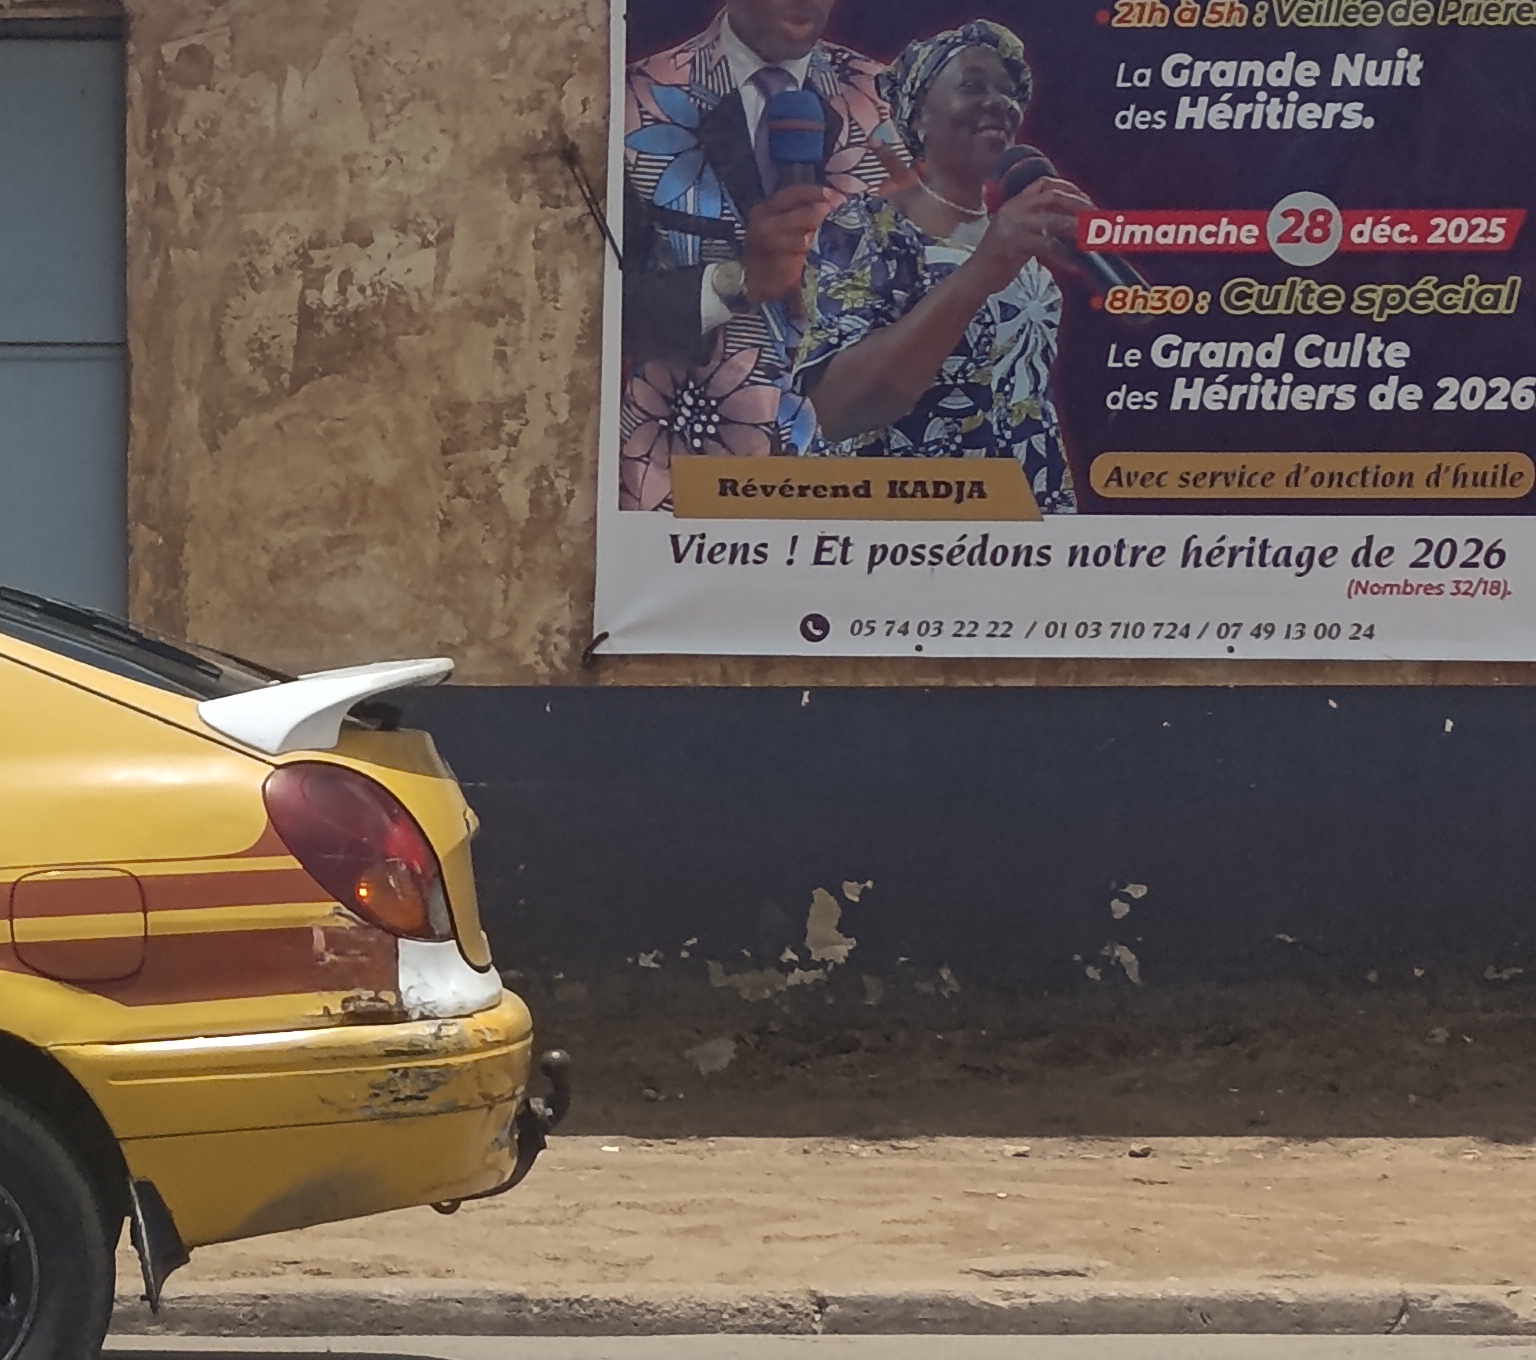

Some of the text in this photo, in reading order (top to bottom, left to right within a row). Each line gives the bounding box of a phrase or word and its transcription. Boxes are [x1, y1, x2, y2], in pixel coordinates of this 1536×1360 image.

[1116, 48, 1424, 88] La Grande Nuit
[1114, 91, 1375, 130] des Héritiers.
[1086, 208, 1507, 245] Dimanche 28 déc. 2025
[1104, 285, 1193, 315] 8h30
[1220, 277, 1346, 315] Culte
[1351, 274, 1522, 322] spécial
[1107, 333, 1411, 368] Le Grand Culte
[1106, 373, 1536, 411] des Héritiers de 2026
[718, 478, 988, 504] Révérend KADJA
[1102, 462, 1525, 489] Avec service d'onction d'huile
[669, 533, 1507, 577] Viens ! Et possédons notre héritage de 2026
[1346, 578, 1446, 599] (Nombres
[850, 619, 1376, 641] 05 74 03 22 22 / 01 03 710 724 / 07 49 13 00 24
